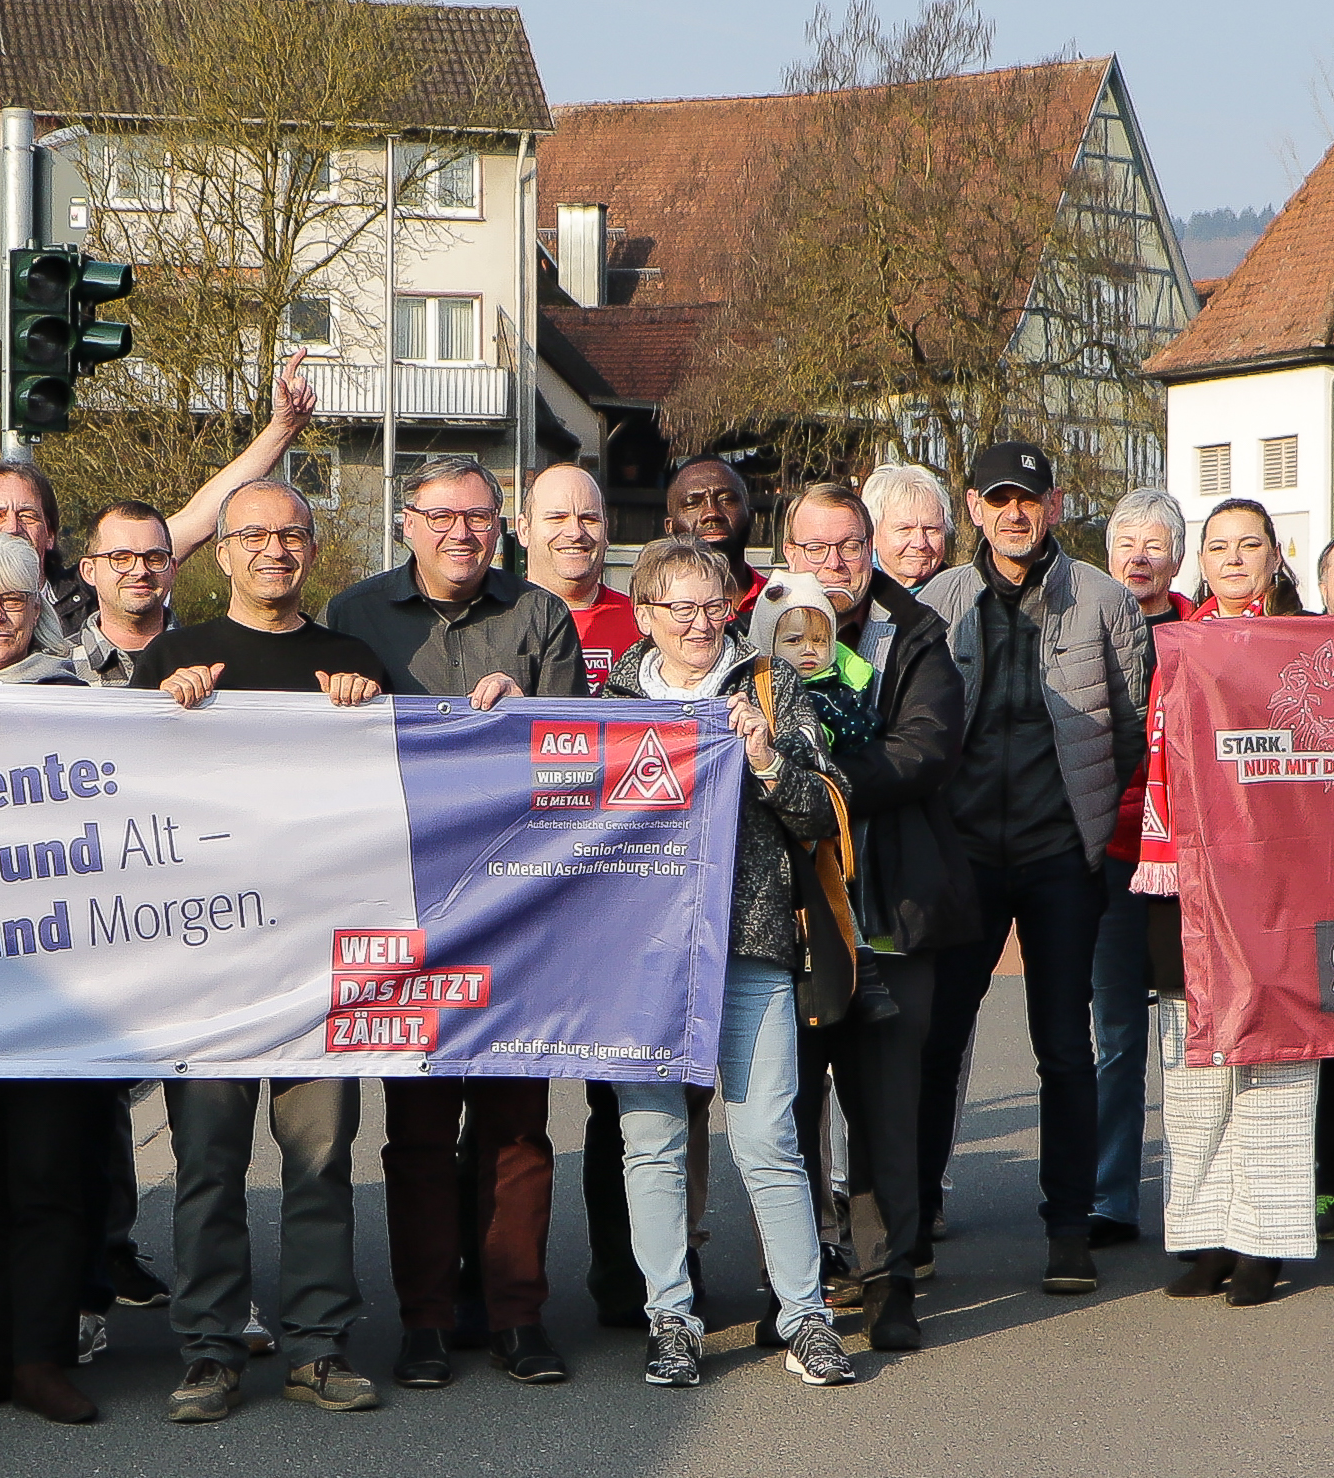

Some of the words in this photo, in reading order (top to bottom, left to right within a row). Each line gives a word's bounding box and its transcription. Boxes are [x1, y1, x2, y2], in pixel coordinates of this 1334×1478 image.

[540, 733, 589, 755] AGA
[1222, 735, 1287, 755] STARK.
[537, 771, 564, 784] WIR
[564, 771, 595, 784] SIND
[1243, 758, 1281, 777] NUR
[1284, 758, 1317, 776] MIT
[536, 796, 548, 807] IG
[549, 795, 591, 806] METALL
[120, 814, 185, 870] Alt
[663, 840, 688, 856] der
[488, 862, 504, 877] IG
[507, 861, 552, 877] Metall
[554, 859, 687, 878] Aschaffenburg-Lohr
[88, 889, 279, 947] Morgen.
[339, 936, 416, 965] WEIL
[339, 979, 394, 1006] DAS
[398, 973, 484, 1006] JETZT
[332, 1011, 429, 1046] ZÄHLT.
[491, 1039, 673, 1062] aschaffenburg.igmetall.de
